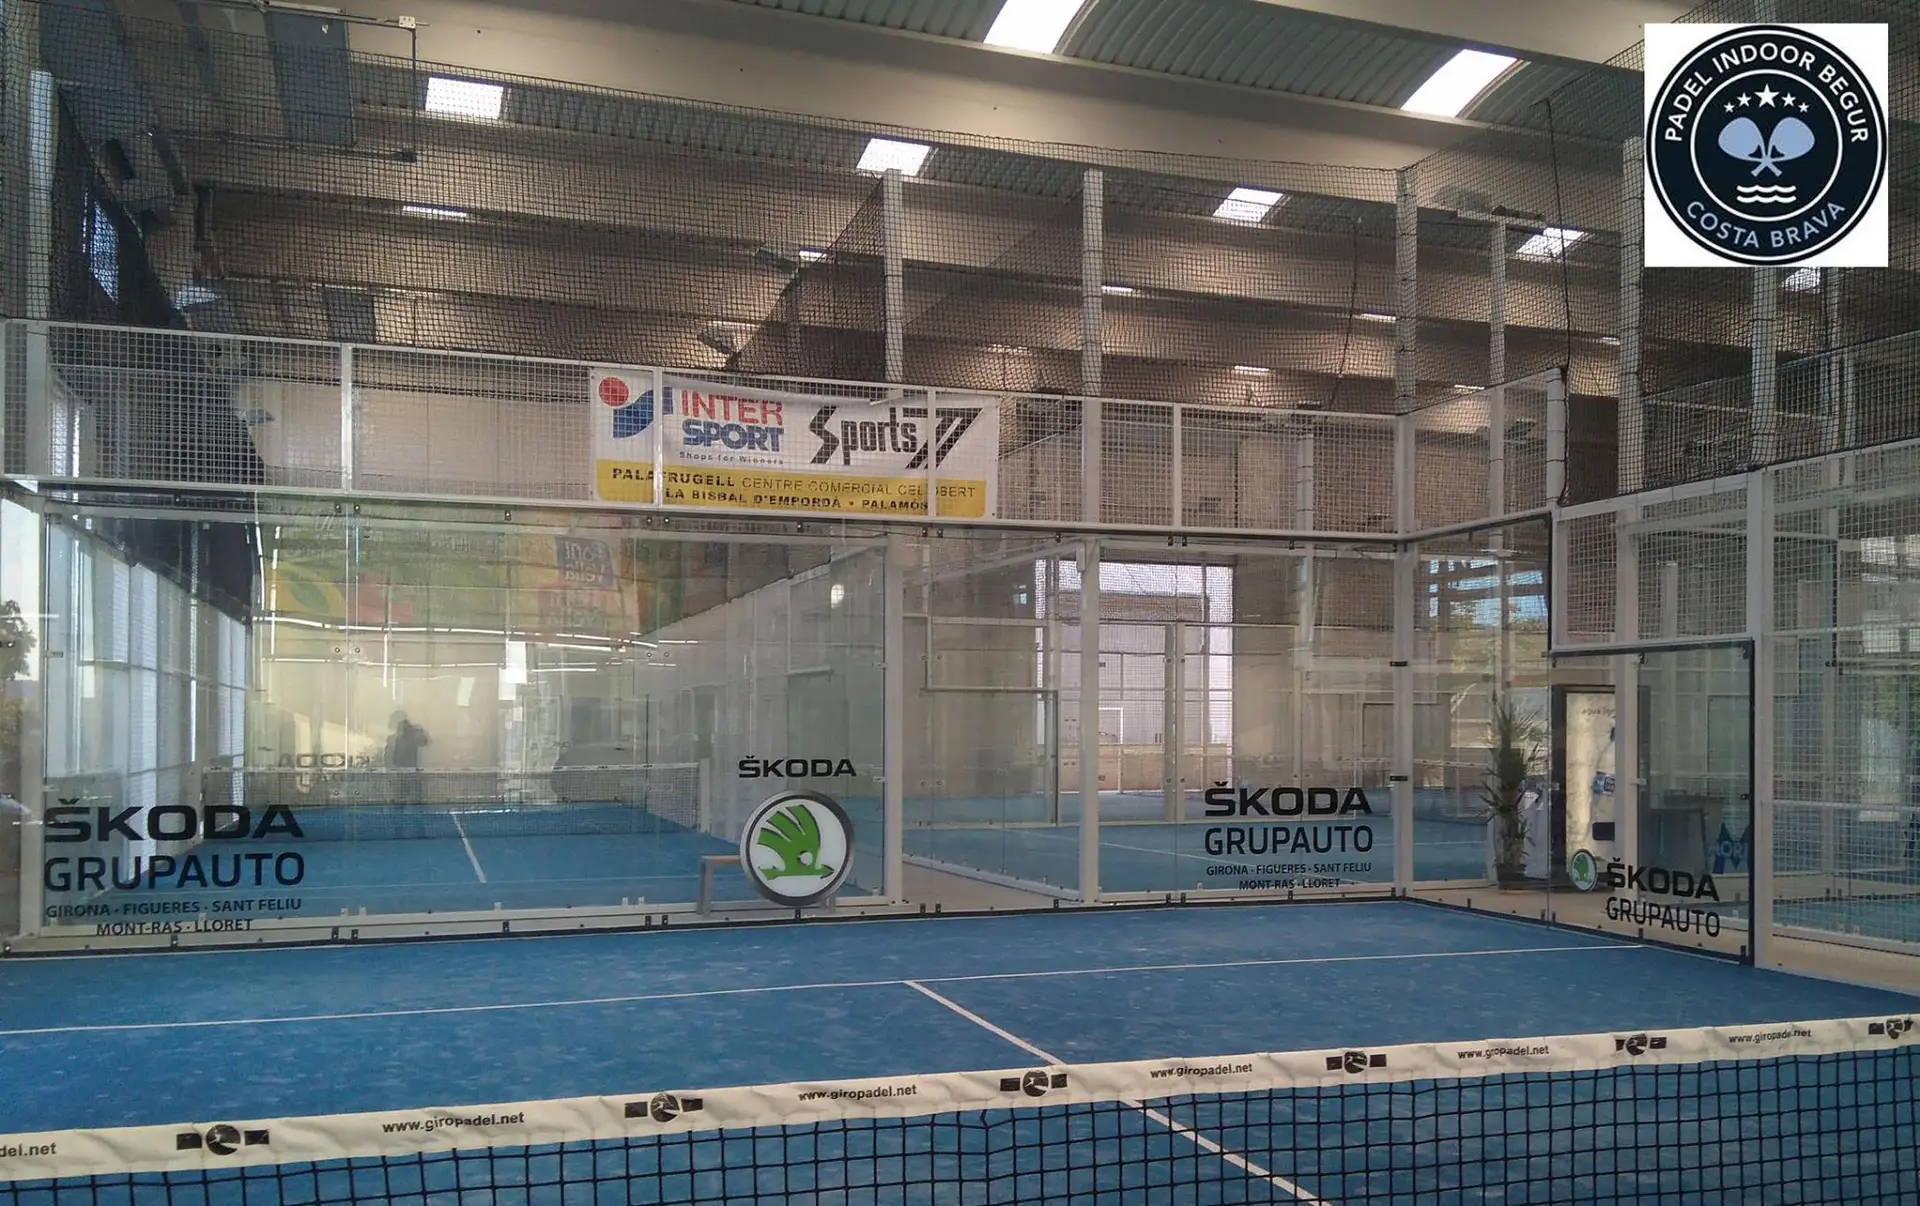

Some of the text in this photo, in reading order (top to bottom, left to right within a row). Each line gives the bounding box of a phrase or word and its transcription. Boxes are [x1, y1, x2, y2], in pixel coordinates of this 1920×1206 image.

[681, 389, 783, 426] INTER
[682, 418, 785, 453] SPORT
[692, 490, 747, 504] BISBAL
[742, 477, 802, 493] CENTRE
[808, 480, 892, 497] COMERCIAL
[738, 755, 857, 778] ŠKODA
[1205, 781, 1373, 817] ŠKODA
[44, 798, 304, 843] ŠKODA
[1205, 825, 1373, 855] GRUPAUTO
[44, 852, 305, 891] GRUPAUTO
[1206, 862, 1372, 876] GIRONA FIGUERES SANT FELIU
[1606, 857, 1720, 901] ŠKODA
[1239, 878, 1341, 890] MONT-RAS LLORET
[46, 898, 302, 918] GIRONA FIGUERES SANT FELIU
[1606, 896, 1721, 938] GRUPAUTO
[96, 918, 254, 936] MONT-RAS LLORET
[1150, 1062, 1253, 1079] www.giropadel.net
[798, 1084, 917, 1101] www.giropadel.net
[382, 1111, 525, 1133] www.giropadel.net
